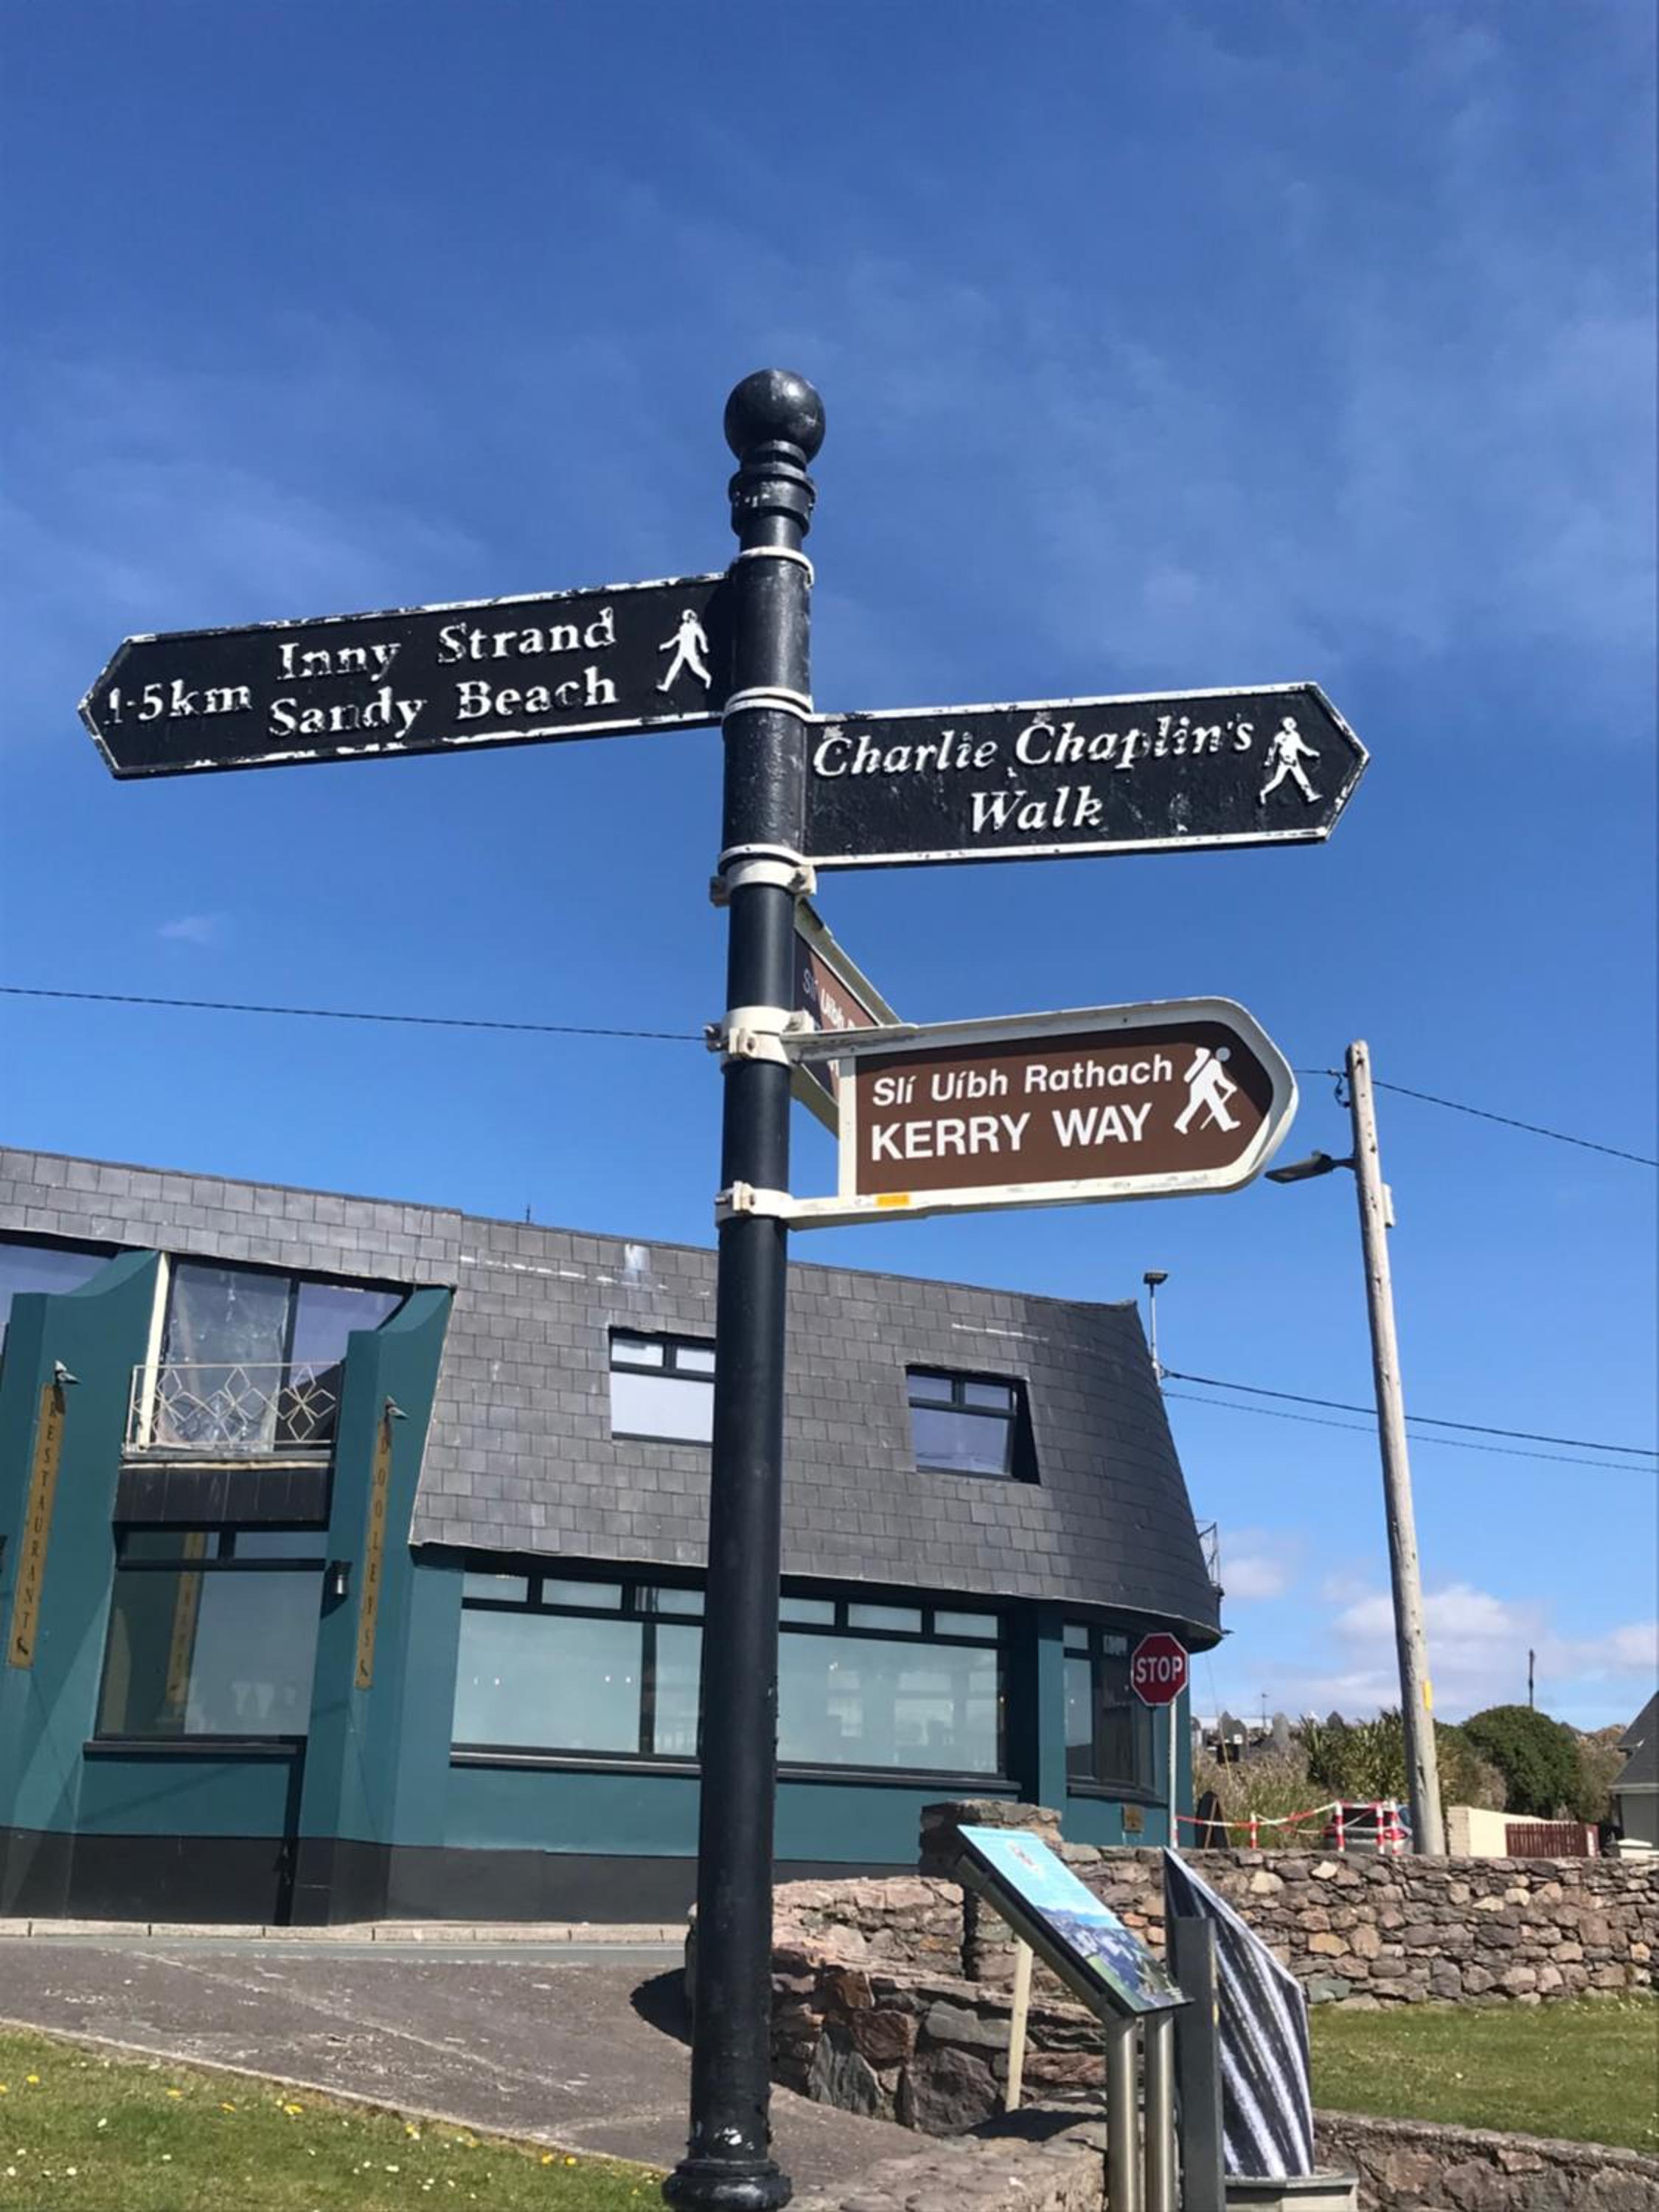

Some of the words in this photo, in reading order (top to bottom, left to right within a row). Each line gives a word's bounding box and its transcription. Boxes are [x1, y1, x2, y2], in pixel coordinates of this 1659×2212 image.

[276, 641, 402, 682] Inny
[437, 606, 616, 666] Strand
[268, 686, 428, 738] Sandy
[456, 666, 619, 720] Beach
[813, 730, 998, 776] Charlie
[1014, 714, 1255, 773] Chaplin's
[972, 786, 1104, 832] Walk
[872, 1074, 916, 1107] Slí
[931, 1068, 1009, 1101] Uíbh
[1024, 1053, 1172, 1093] Rathach
[872, 1112, 1032, 1161] KERRY
[1051, 1102, 1152, 1147] WAY
[1135, 1656, 1183, 1683] STOP
